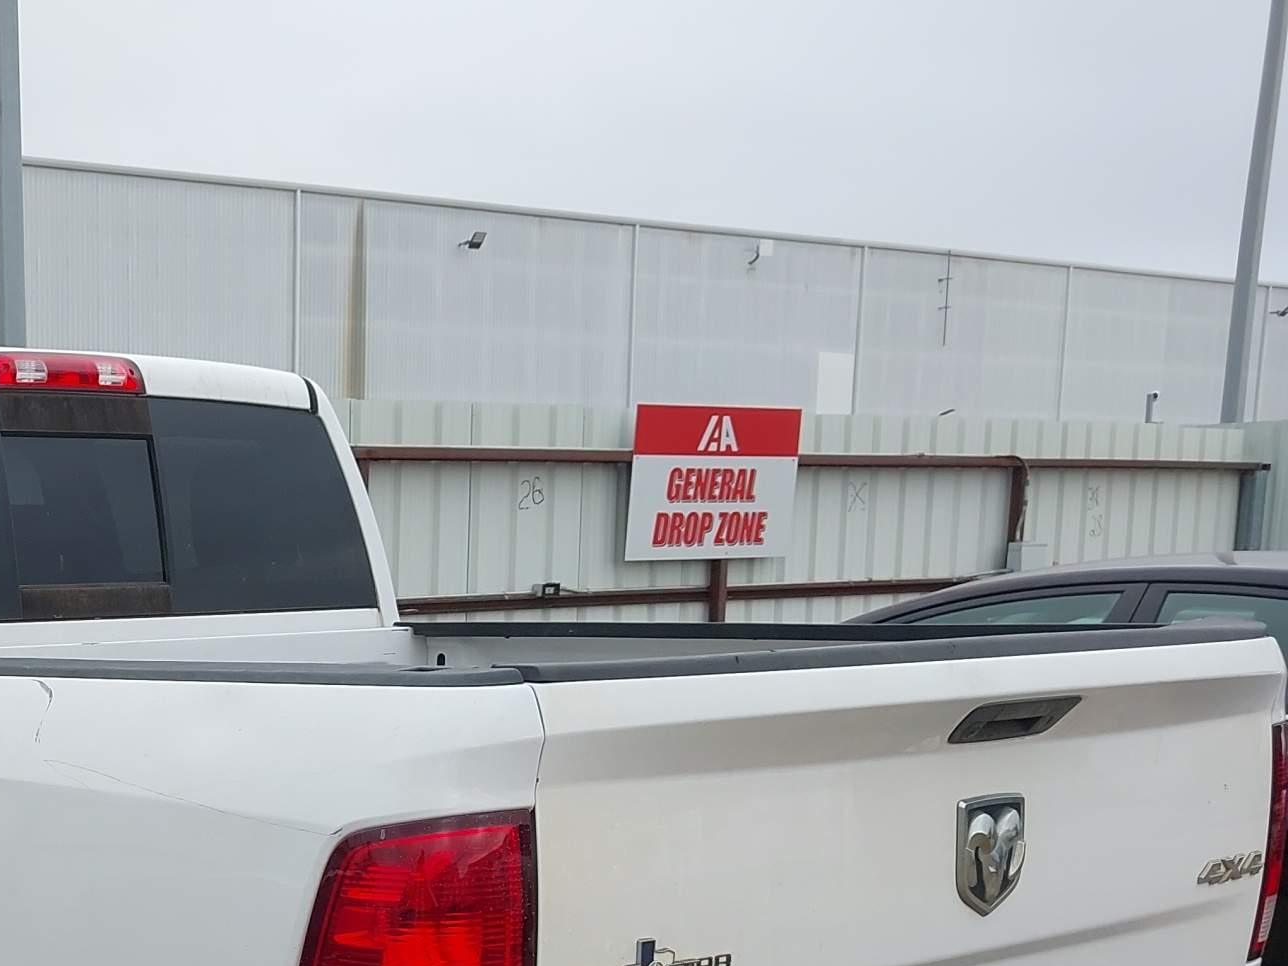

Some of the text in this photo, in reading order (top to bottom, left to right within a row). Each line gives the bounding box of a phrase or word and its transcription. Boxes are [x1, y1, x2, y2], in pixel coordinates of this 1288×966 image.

[518, 476, 545, 510] 26
[666, 467, 757, 503] GENERAL
[652, 511, 768, 547] DROP ZONE
